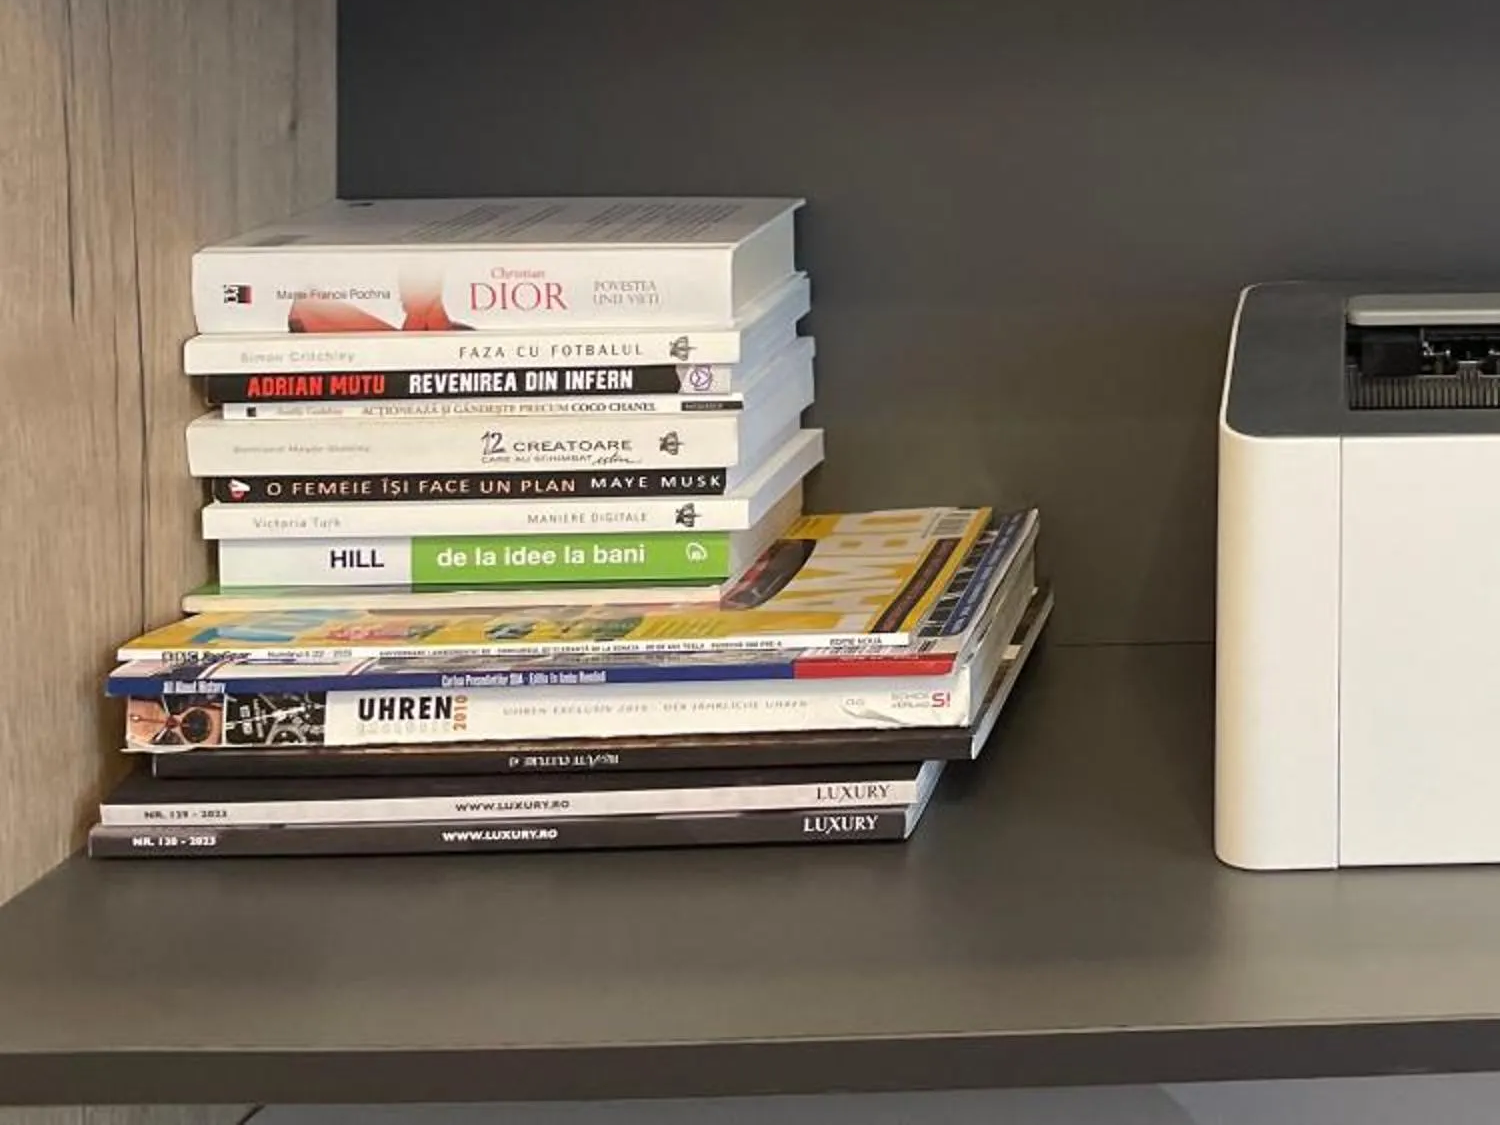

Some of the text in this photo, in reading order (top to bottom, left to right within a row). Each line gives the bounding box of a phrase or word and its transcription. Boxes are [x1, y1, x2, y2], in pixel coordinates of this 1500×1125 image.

[490, 266, 545, 280] Christian
[350, 288, 391, 300] Pochna
[593, 280, 657, 293] POVESTEA
[470, 282, 568, 311] DIOR
[458, 343, 644, 359] FAZA CU FOTBALUL
[247, 369, 633, 396] ADRIAN MUTU REVENIREA DIN INFERN
[518, 401, 570, 413] PRECUM
[571, 401, 606, 413] COCO
[608, 401, 656, 412] CHANEL
[481, 430, 633, 456] 12 CREATOARE
[481, 456, 512, 464] CARE
[533, 454, 593, 463] SCHIMBAT
[266, 483, 282, 496] O
[292, 481, 372, 496] FEMEIE
[418, 479, 470, 493] FACE
[479, 479, 511, 494] UN
[520, 479, 576, 493] PLAN
[591, 476, 648, 489] MAYE
[661, 475, 722, 489] MUSK
[253, 516, 307, 529] Victoria
[527, 512, 648, 525] MANIERE DIGITALE
[330, 549, 385, 569] HILL
[437, 543, 646, 567] de la idee la bani
[198, 681, 226, 694] History
[358, 695, 453, 722] UHREN
[453, 695, 469, 732] 2010
[502, 706, 548, 716] UHREN
[144, 810, 166, 819] NR.
[201, 810, 227, 818] 2023
[455, 797, 570, 813] WWW.LUXURY.RO
[817, 784, 890, 802] LUXURY
[132, 836, 155, 846] NR.
[189, 835, 217, 846] 2023
[442, 827, 558, 844] WWW.LUXURY.RO
[803, 815, 879, 834] LUXURY
